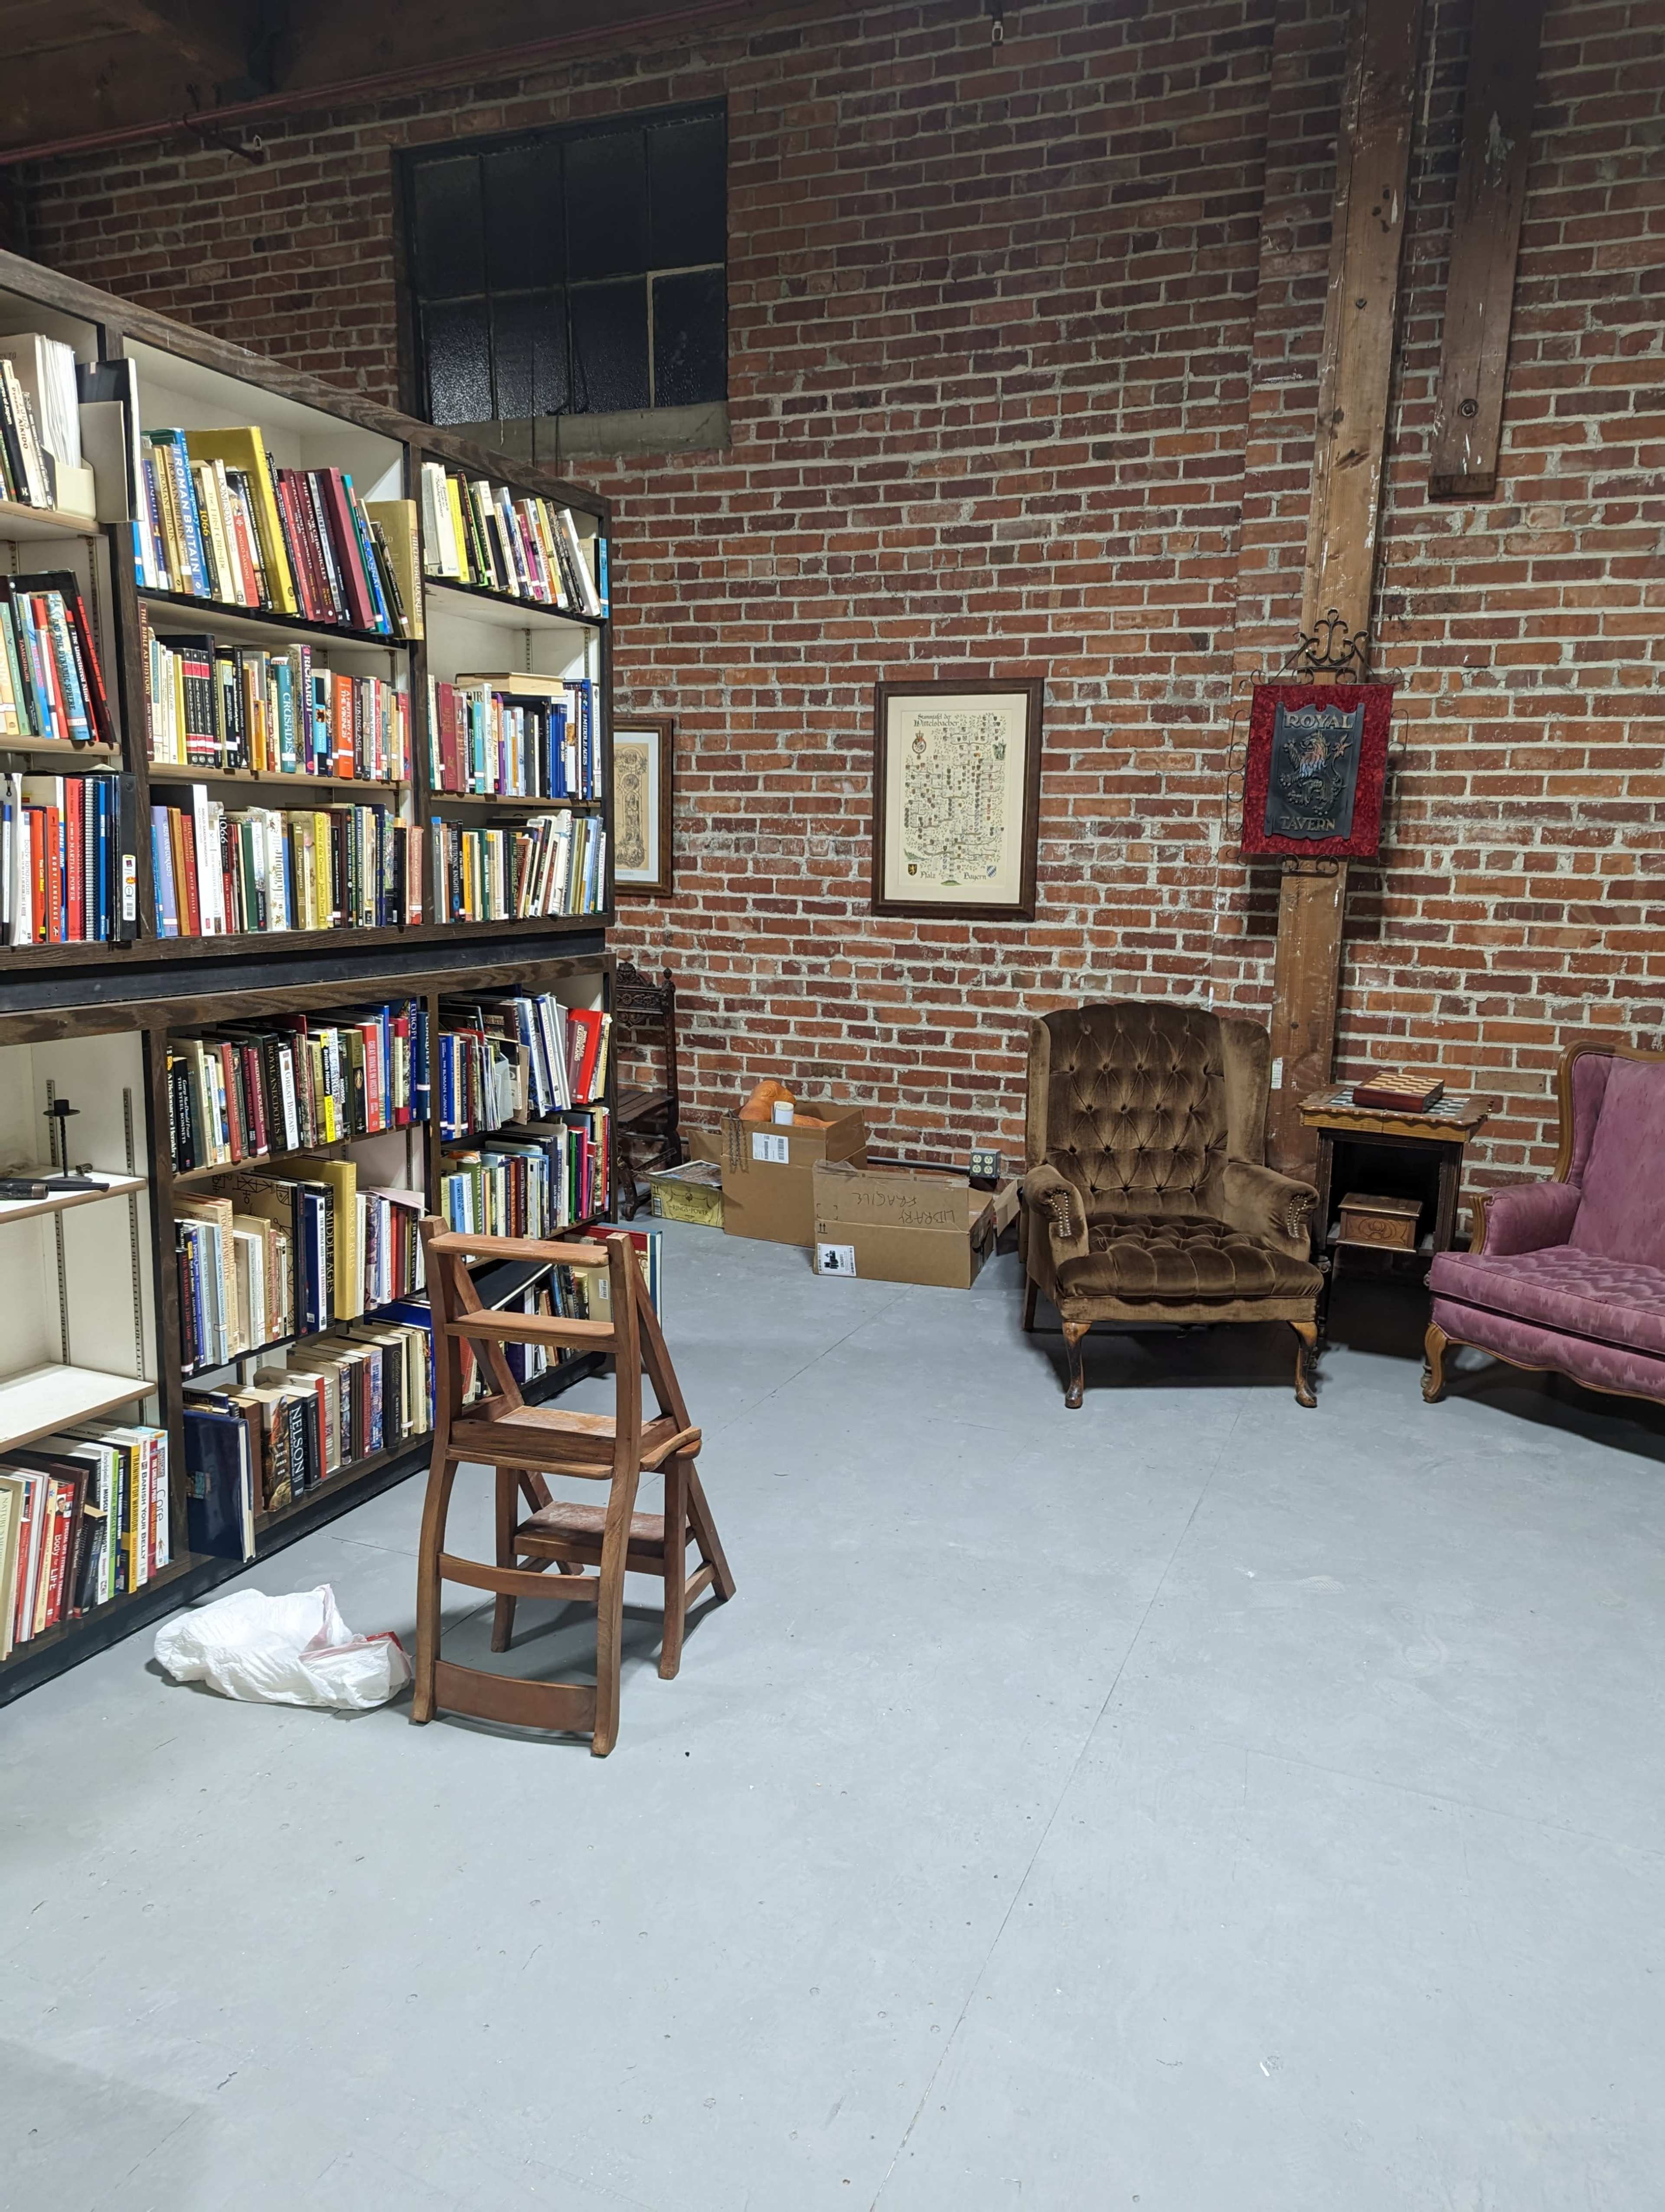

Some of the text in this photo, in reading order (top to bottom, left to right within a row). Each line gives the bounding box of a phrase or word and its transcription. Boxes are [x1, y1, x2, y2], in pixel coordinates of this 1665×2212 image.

[18, 418, 29, 450] AIKIDO
[168, 463, 185, 539] ROMAN BRITAIN
[174, 458, 200, 572] ROMAN BRITAIN
[218, 478, 233, 528] DOMESDAY
[165, 509, 174, 541] BRITAIN
[200, 510, 209, 536] 1066
[291, 489, 304, 531] PLANTAGENET
[301, 532, 313, 569] CHRONICLES
[305, 499, 316, 528] TUDOR
[312, 529, 327, 580] CHRONICLES
[20, 639, 30, 682] TAMESHIGIRI
[52, 619, 61, 632] AND
[59, 650, 71, 682] DYNAMIC
[65, 683, 75, 710] SPHERE
[75, 646, 85, 682] Unfettered
[144, 650, 149, 660] AS
[304, 656, 312, 705] RICHARD
[283, 692, 294, 753] CRUSADES
[346, 732, 352, 743] OF
[1284, 714, 1353, 729] ROYAL
[219, 816, 229, 844] 1066
[1279, 816, 1335, 831] TAVERN
[964, 872, 986, 882] Bayern
[528, 1010, 538, 1051] CASTLES
[268, 1046, 281, 1134] ROYAL ANECDOTES
[691, 1208, 708, 1216] POWER
[852, 1191, 916, 1207] FRAGILE
[349, 1226, 356, 1239] OF
[898, 1209, 955, 1225] LIBRARY
[326, 1210, 334, 1258] MIDDLE
[291, 1405, 304, 1474] NELSON
[156, 1489, 166, 1521] Core
[51, 1534, 62, 1556] Body
[49, 1568, 59, 1591] LIFE
[56, 1580, 64, 1606] TRAINING
